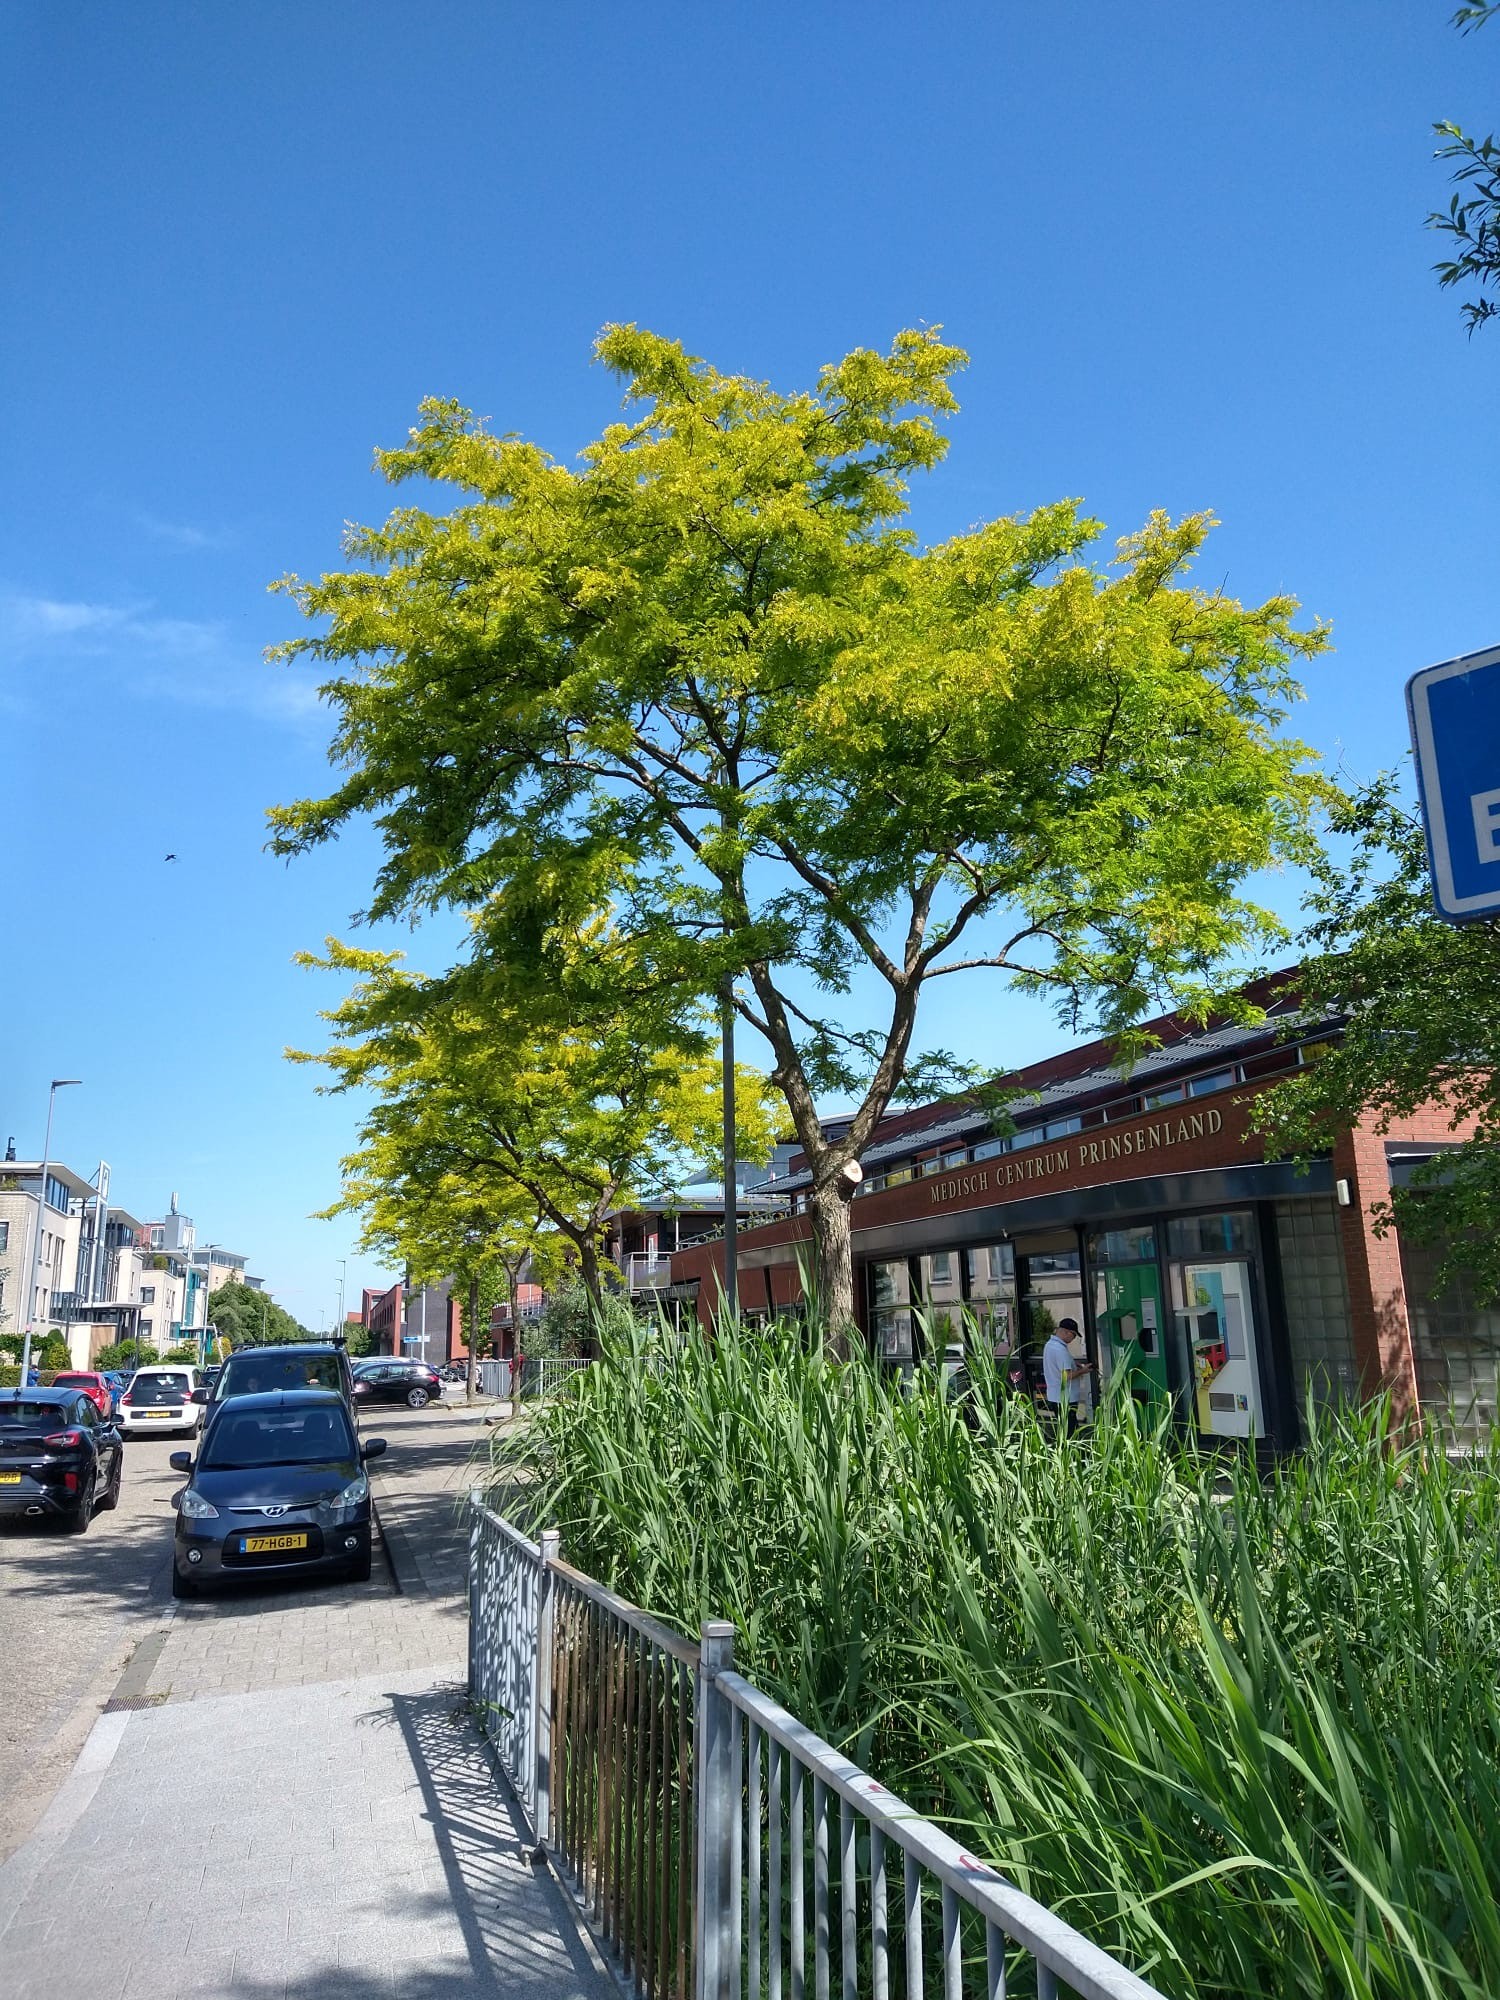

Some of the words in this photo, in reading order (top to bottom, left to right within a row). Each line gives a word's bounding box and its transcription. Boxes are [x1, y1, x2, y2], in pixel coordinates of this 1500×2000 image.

[930, 1171, 989, 1204] MEDISCH
[996, 1149, 1070, 1187] CENTRUM
[1079, 1109, 1223, 1167] PRINSENLAND
[251, 1536, 302, 1551] 77-HGB-1
